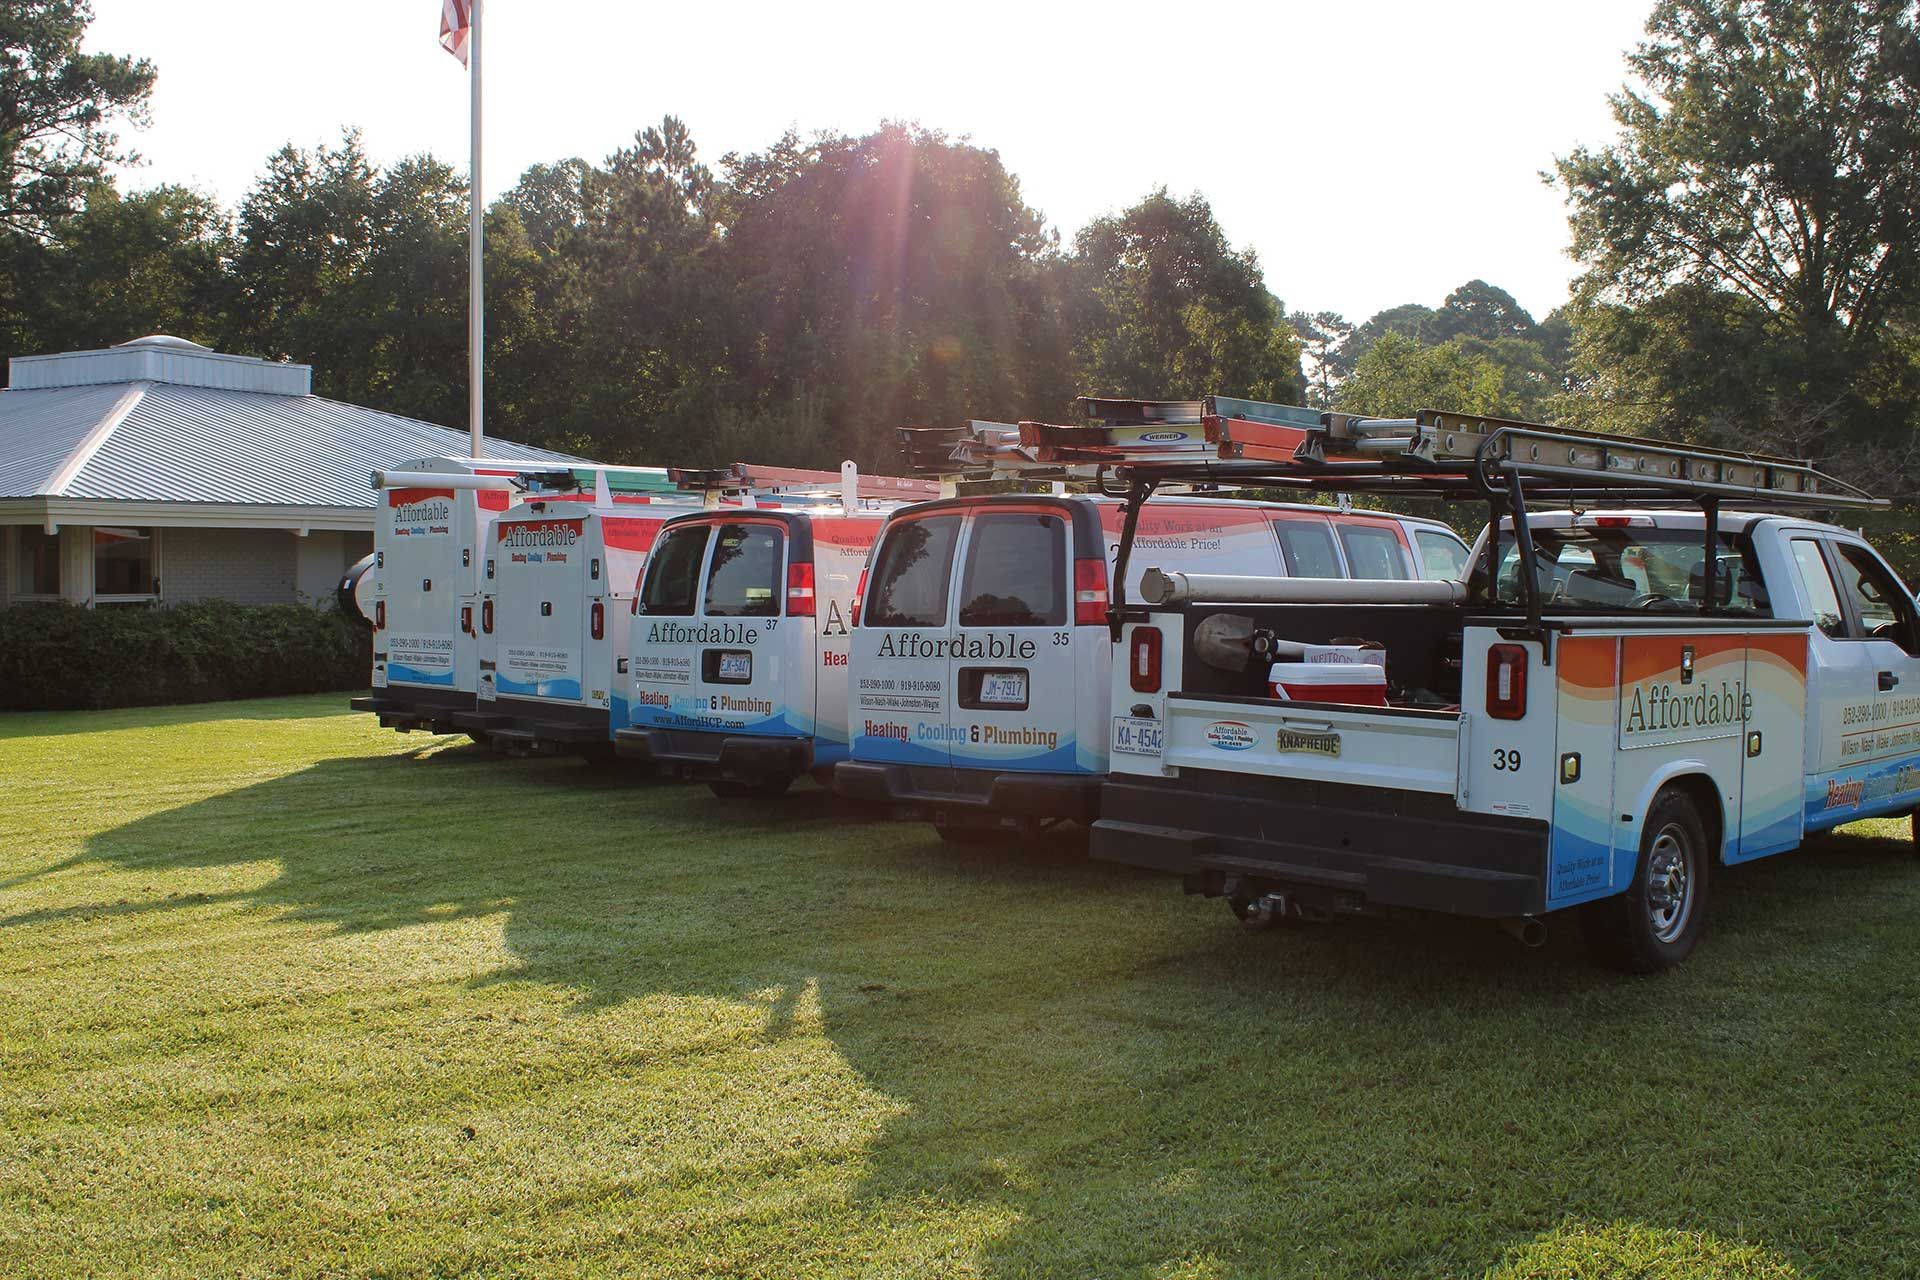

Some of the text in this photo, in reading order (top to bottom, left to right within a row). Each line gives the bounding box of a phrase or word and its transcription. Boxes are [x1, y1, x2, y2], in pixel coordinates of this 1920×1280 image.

[394, 504, 449, 523] Affordable
[1163, 519, 1193, 532] Work
[1209, 524, 1222, 534] an
[505, 526, 577, 547] Affordable
[831, 535, 865, 546] Quality
[1190, 537, 1221, 550] Price!
[647, 622, 758, 645] Affordable
[765, 618, 778, 631] 37
[878, 632, 1036, 659] Affordable
[1052, 631, 1070, 647] 35
[824, 650, 849, 666] Hea
[602, 697, 610, 708] 45
[710, 695, 717, 710] &
[720, 695, 772, 716] Plumbing
[1626, 681, 1752, 732] Affordable
[864, 719, 1058, 750] Heating, Cooling & Plumbing
[1213, 726, 1248, 736] Affordable
[1279, 731, 1337, 754] KNAPHEIDE
[1493, 748, 1521, 772] 39
